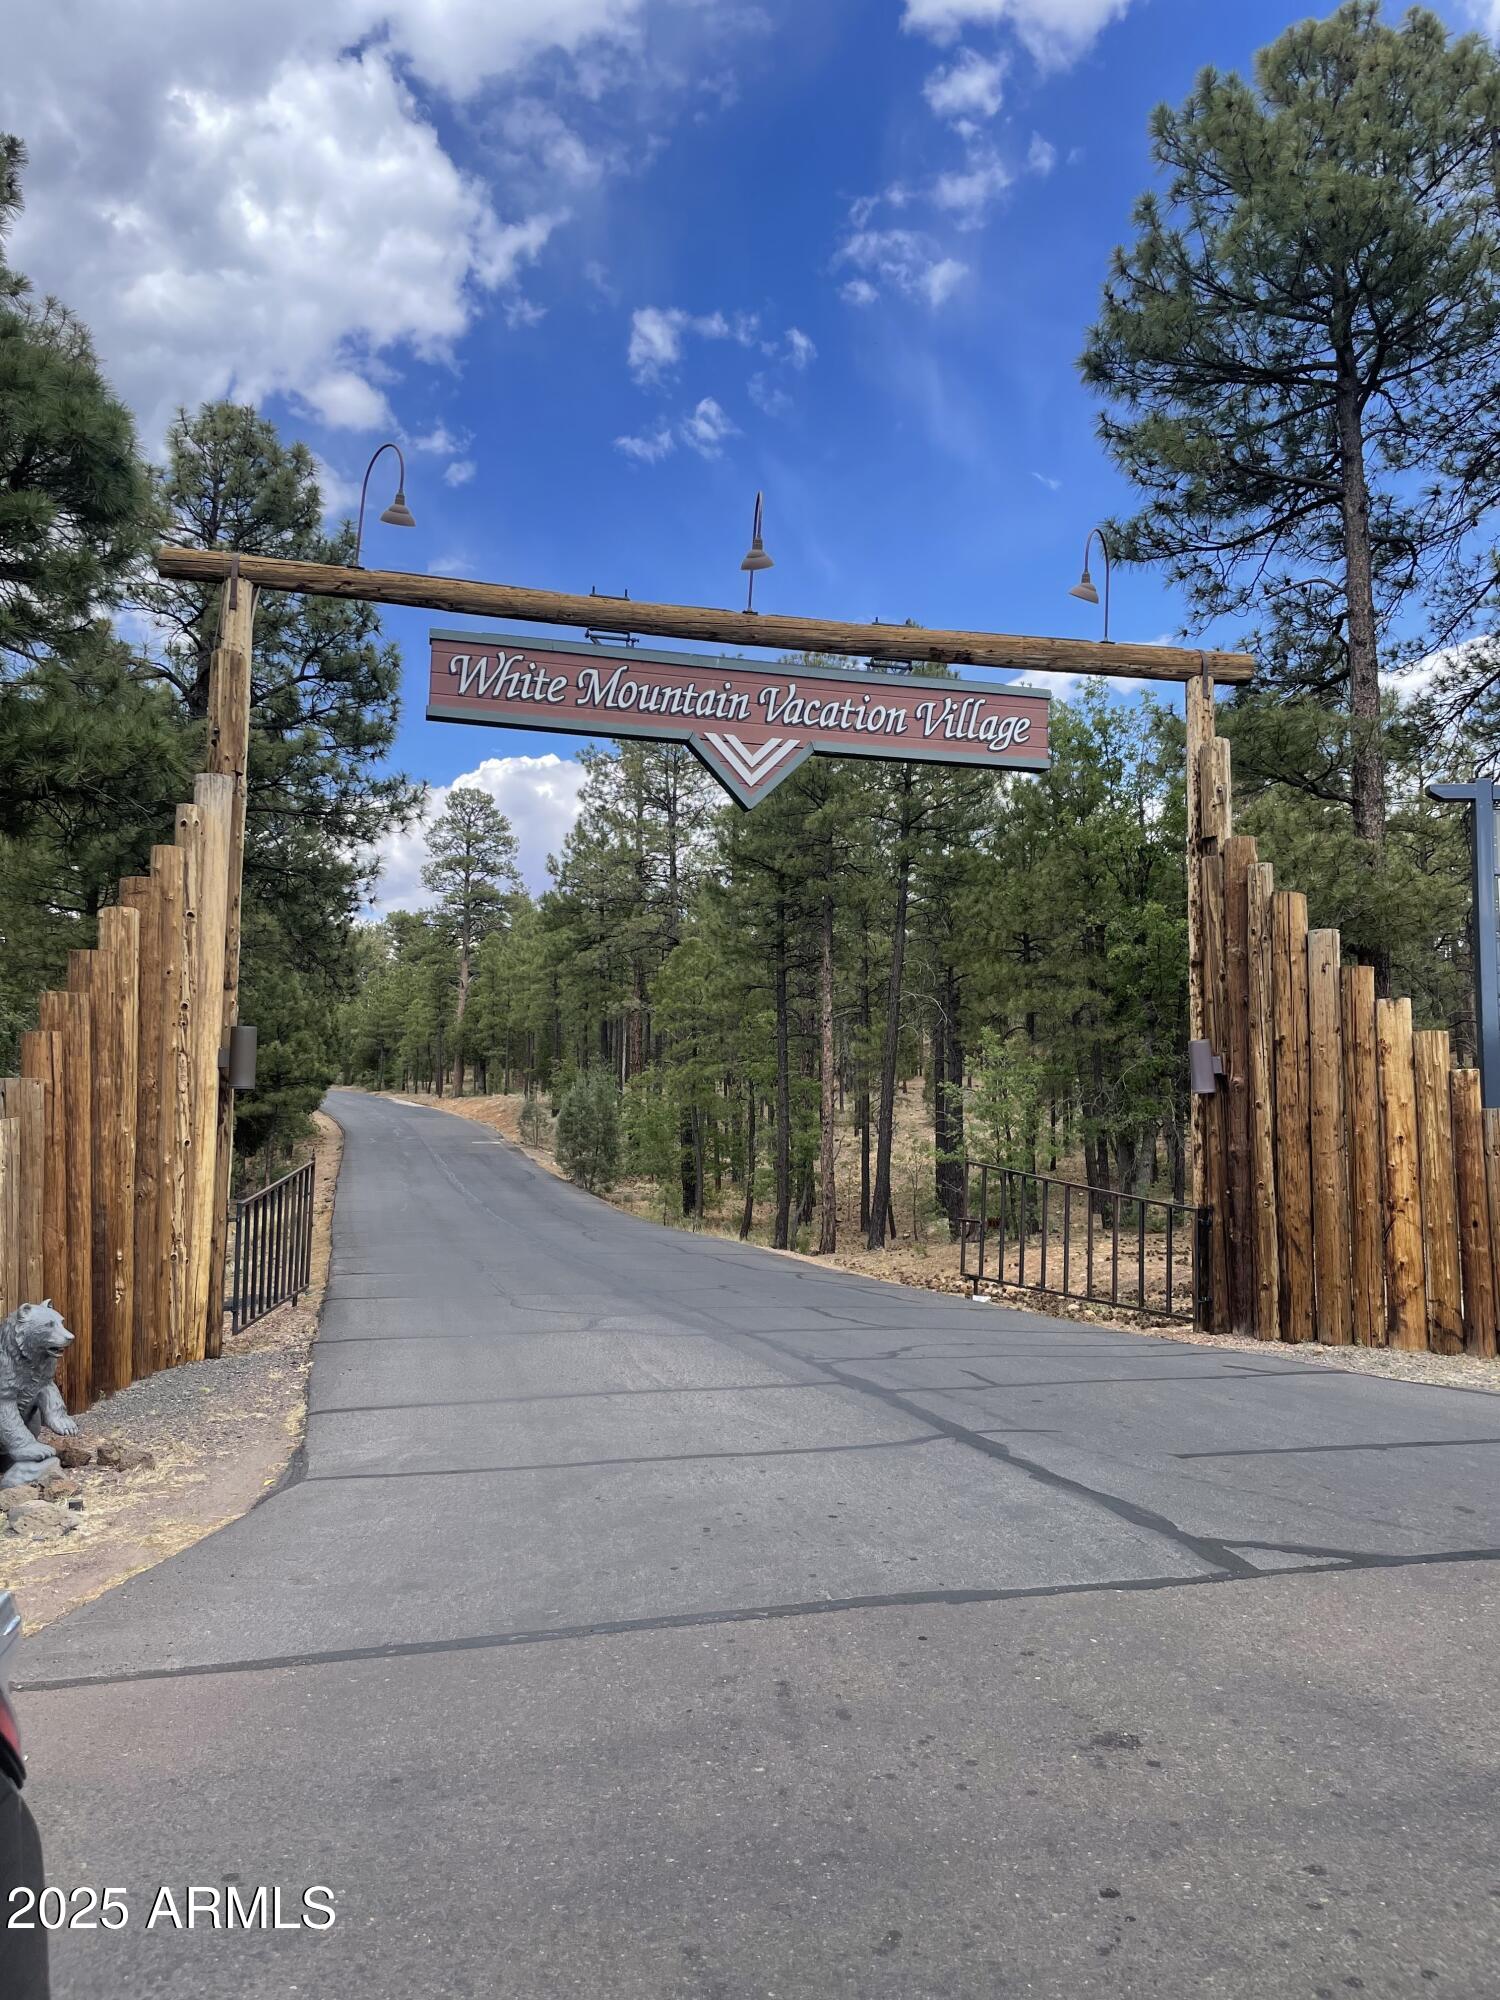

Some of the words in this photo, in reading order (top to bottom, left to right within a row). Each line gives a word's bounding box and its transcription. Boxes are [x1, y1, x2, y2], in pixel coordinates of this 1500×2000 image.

[450, 652, 567, 702] White
[577, 665, 751, 720] Mountain
[759, 683, 908, 734] Vacation
[916, 697, 1031, 750] Village
